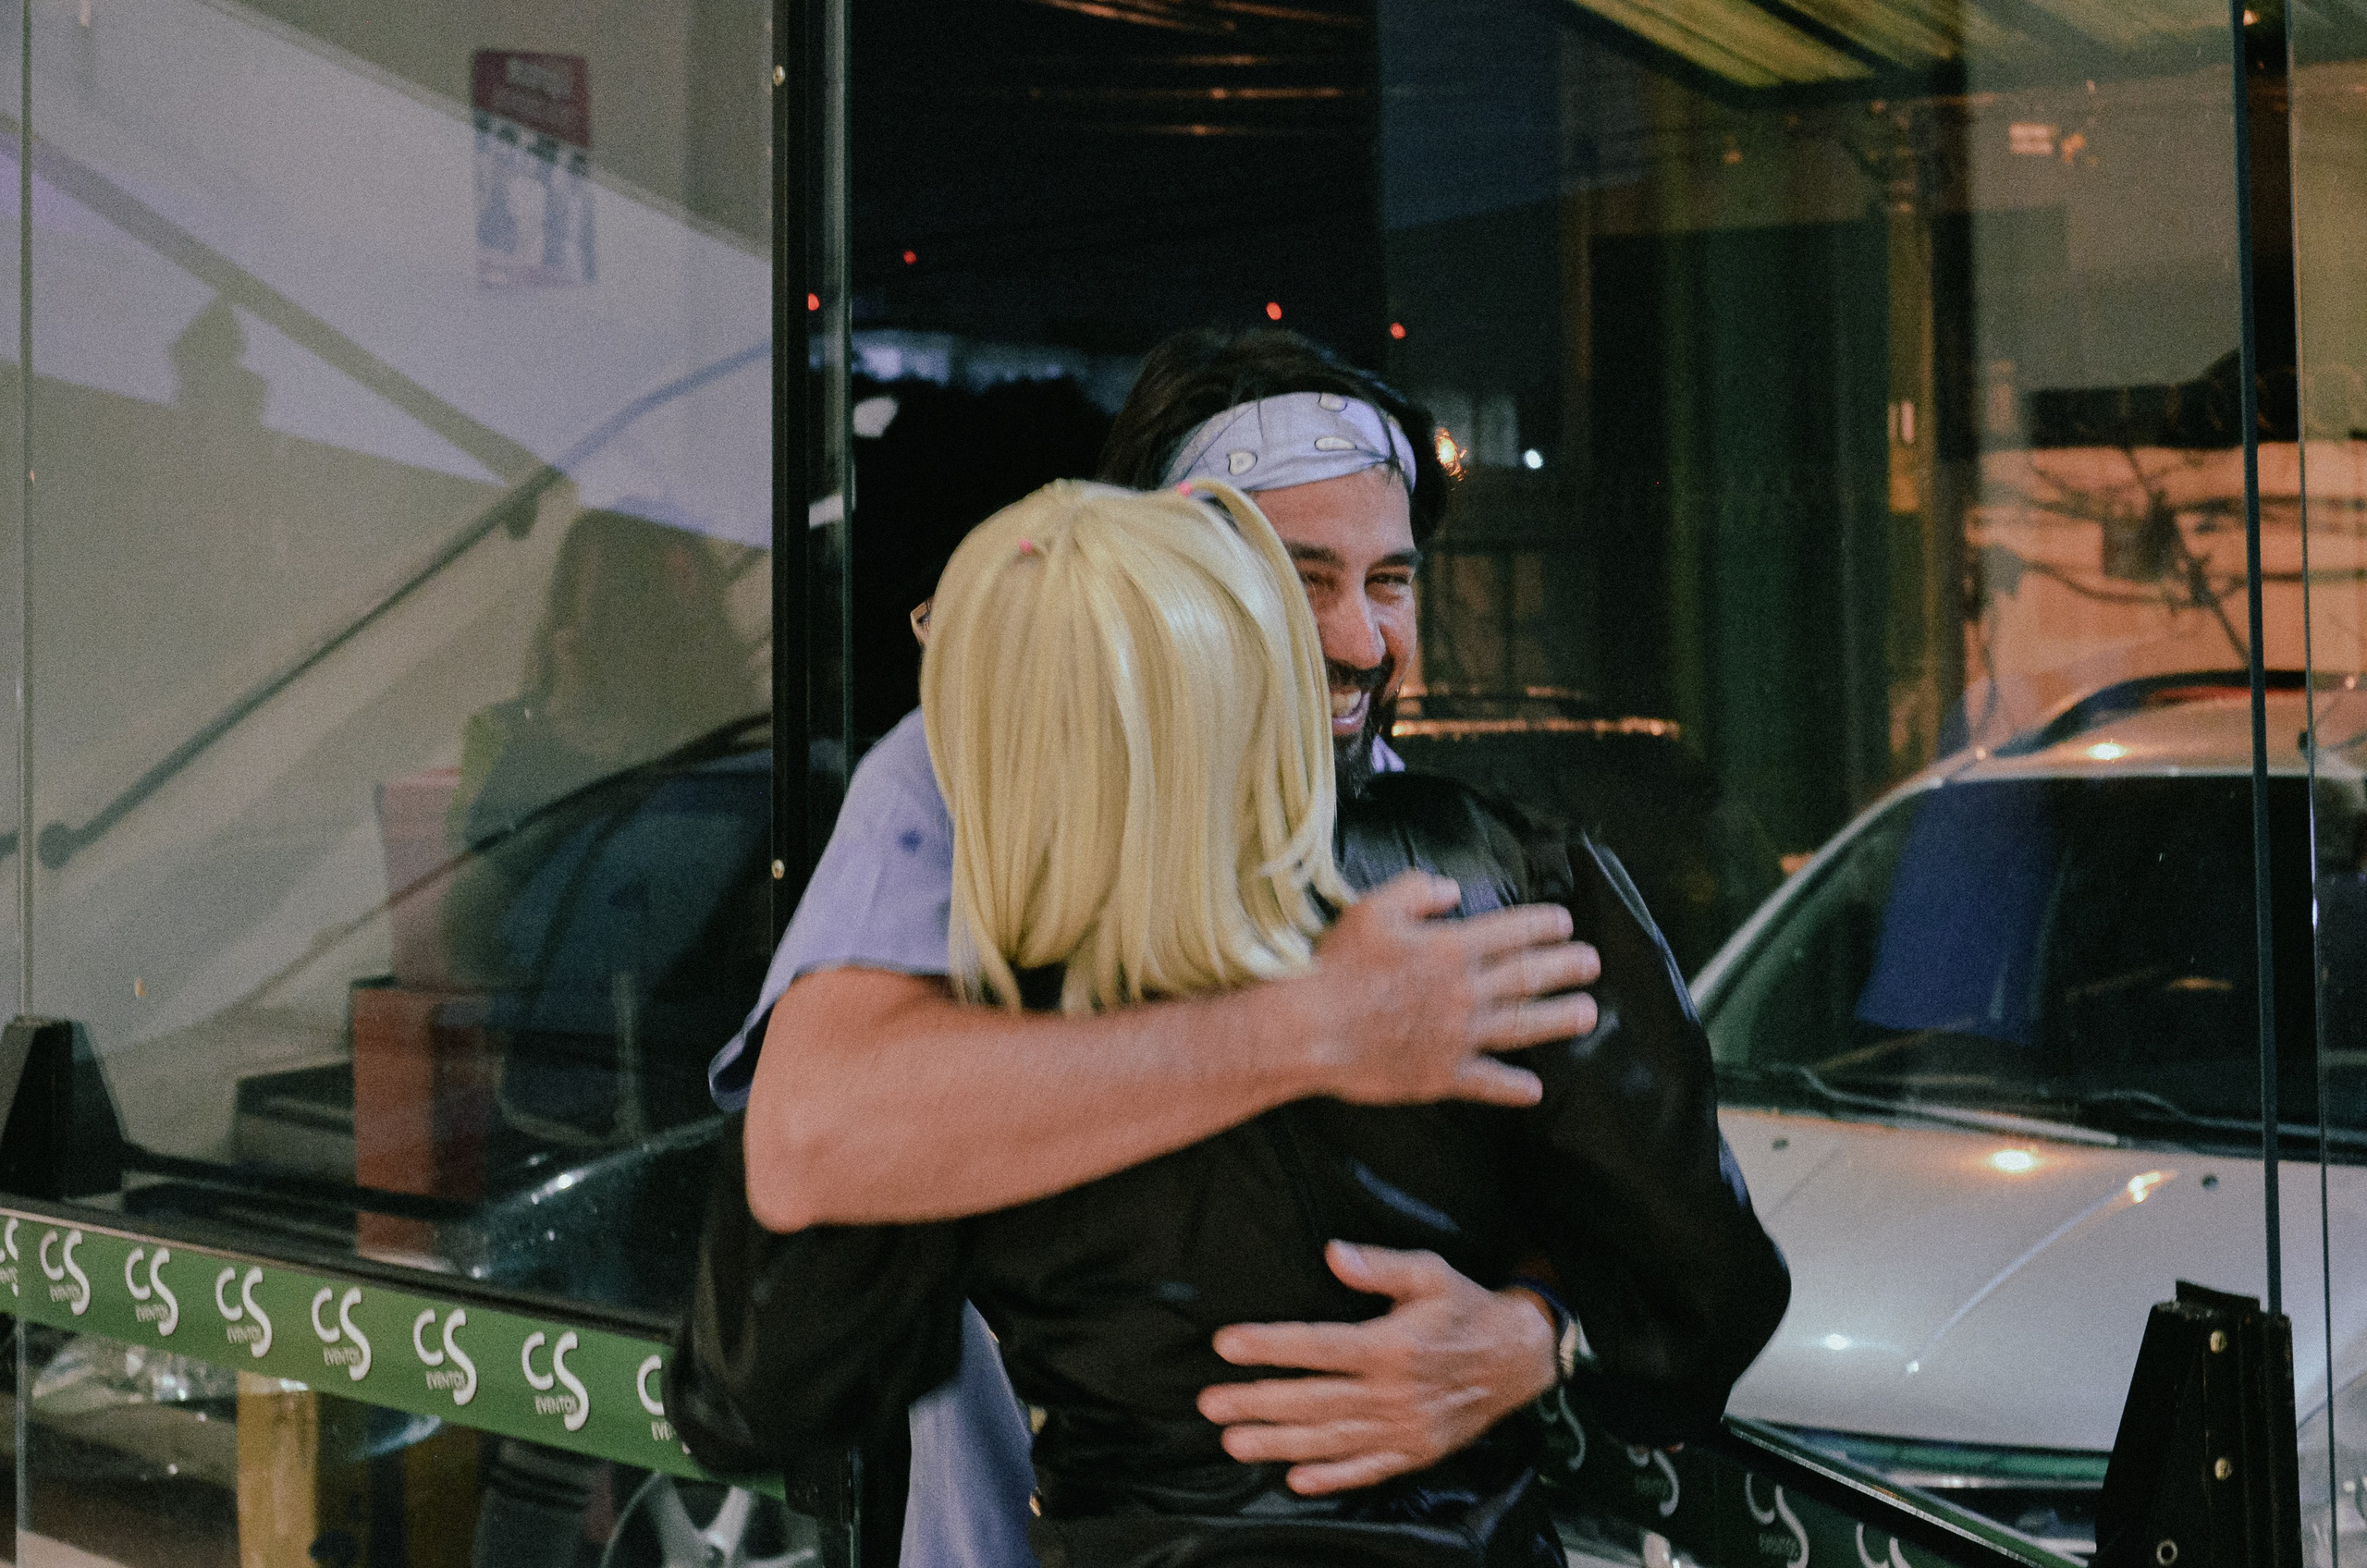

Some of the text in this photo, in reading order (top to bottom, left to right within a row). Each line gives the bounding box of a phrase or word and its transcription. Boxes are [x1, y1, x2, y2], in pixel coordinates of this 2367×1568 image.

[39, 1229, 91, 1316] CS
[125, 1247, 178, 1336] CS
[215, 1266, 272, 1358] CS
[312, 1286, 371, 1381] CS
[413, 1308, 477, 1405] CS
[521, 1330, 590, 1431] CS
